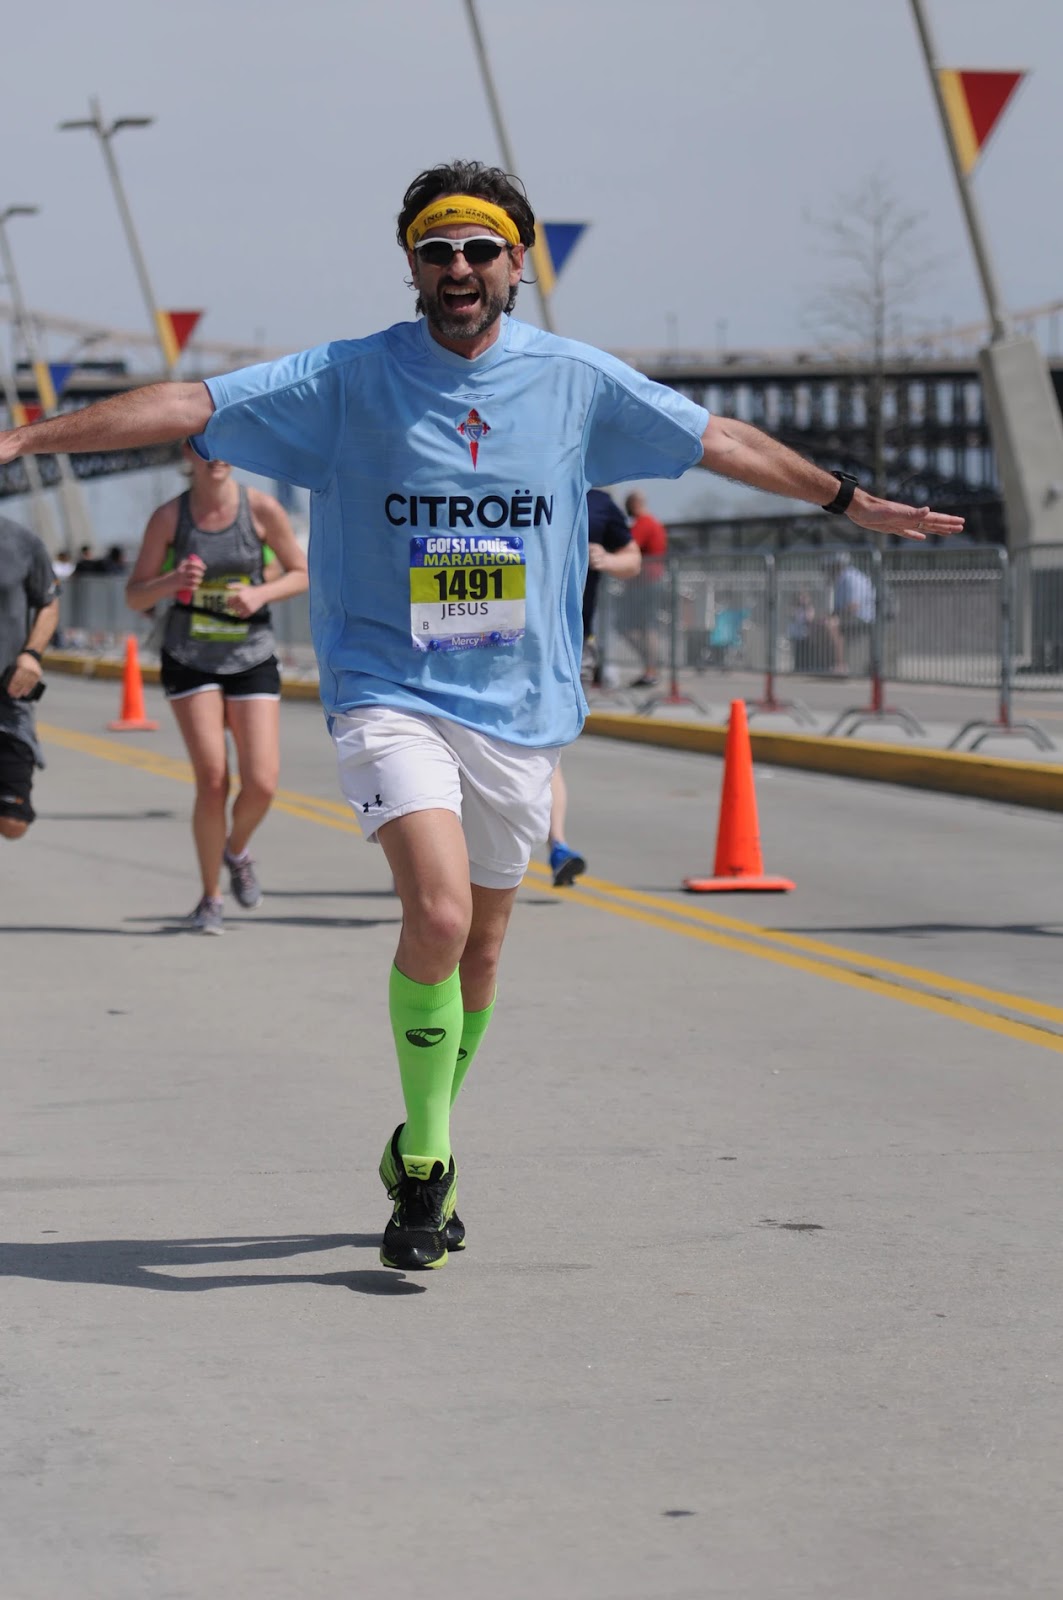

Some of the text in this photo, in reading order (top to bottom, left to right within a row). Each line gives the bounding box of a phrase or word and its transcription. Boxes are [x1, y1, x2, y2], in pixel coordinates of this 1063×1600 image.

[385, 489, 553, 528] CITROËN
[423, 553, 521, 566] MARATHON
[433, 569, 503, 600] 1491
[441, 602, 488, 620] JESUS
[422, 621, 430, 630] B
[451, 637, 479, 646] Mercy
